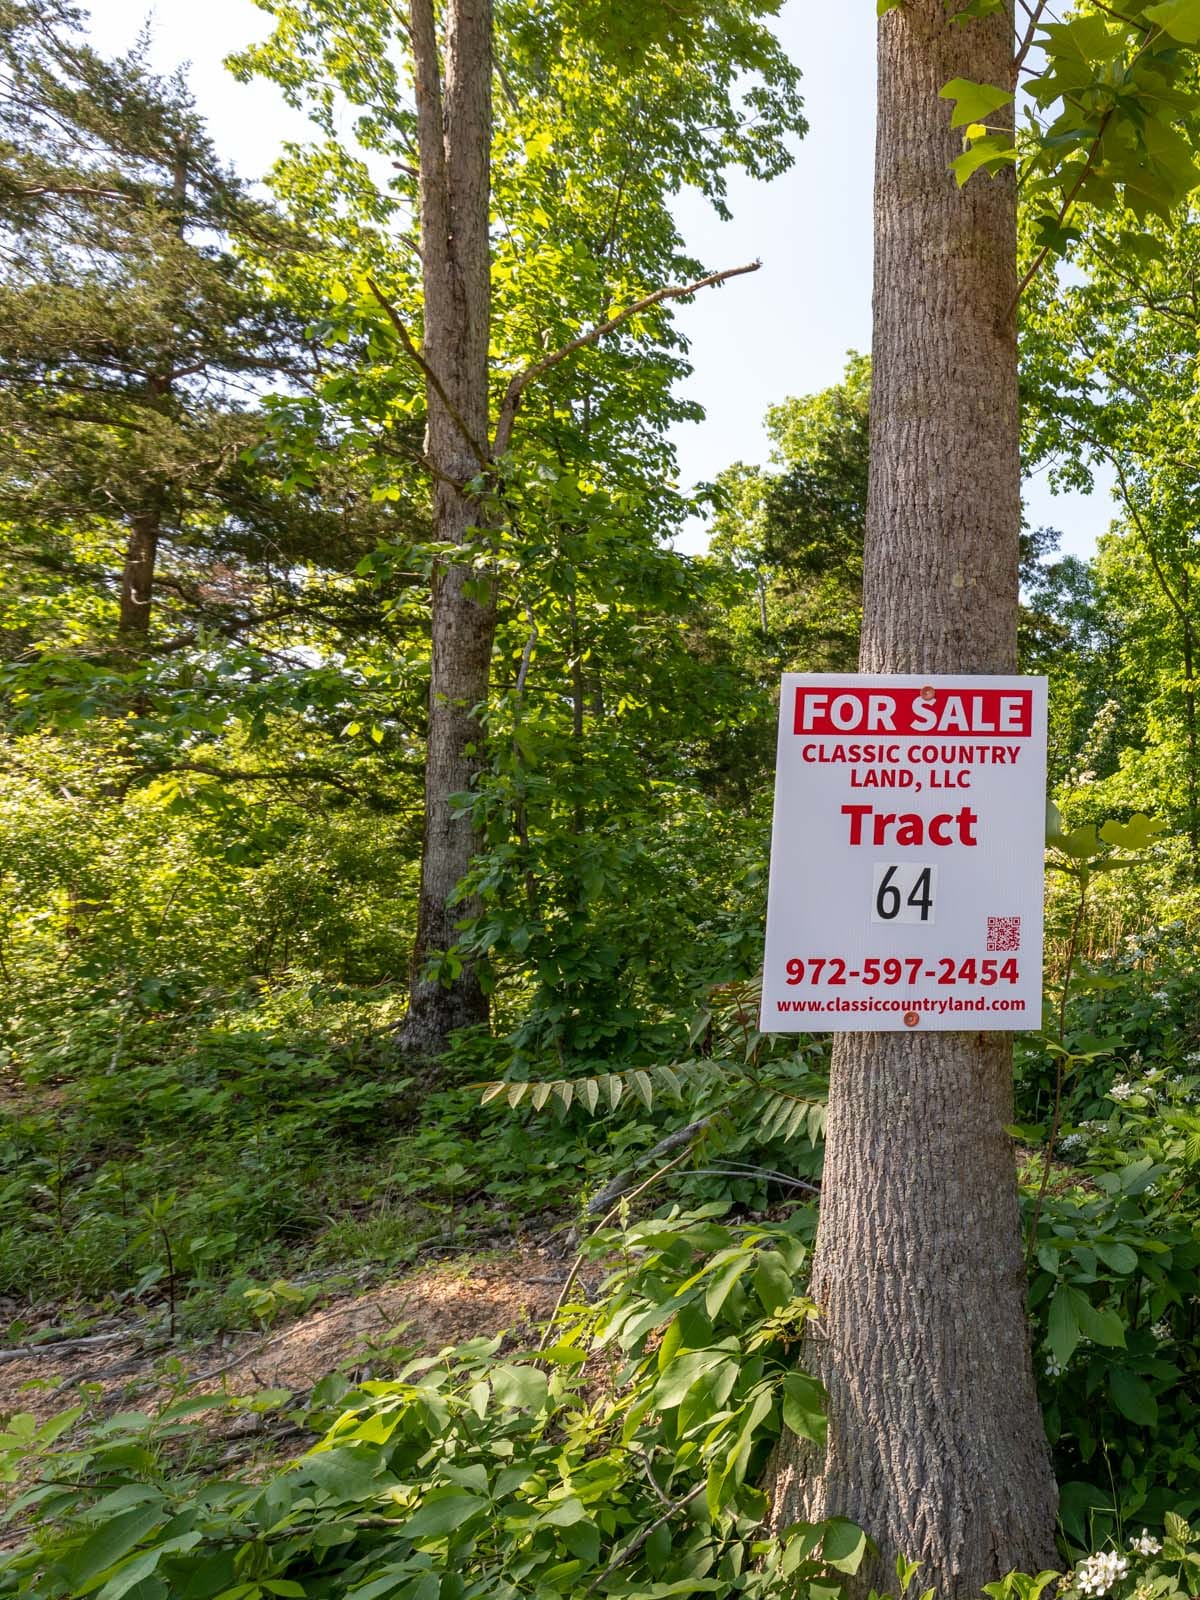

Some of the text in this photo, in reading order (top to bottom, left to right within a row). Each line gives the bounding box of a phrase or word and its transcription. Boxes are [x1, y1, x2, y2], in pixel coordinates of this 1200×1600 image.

[802, 694, 1024, 732] FOR SALE
[802, 744, 1021, 764] CLASSIC COUNTRY
[850, 769, 971, 792] LAND, LLC
[841, 805, 977, 846] Tract
[876, 866, 933, 921] 64
[785, 958, 1019, 986] 972-597-2454
[777, 996, 1026, 1014] www.classiccountryland.com
